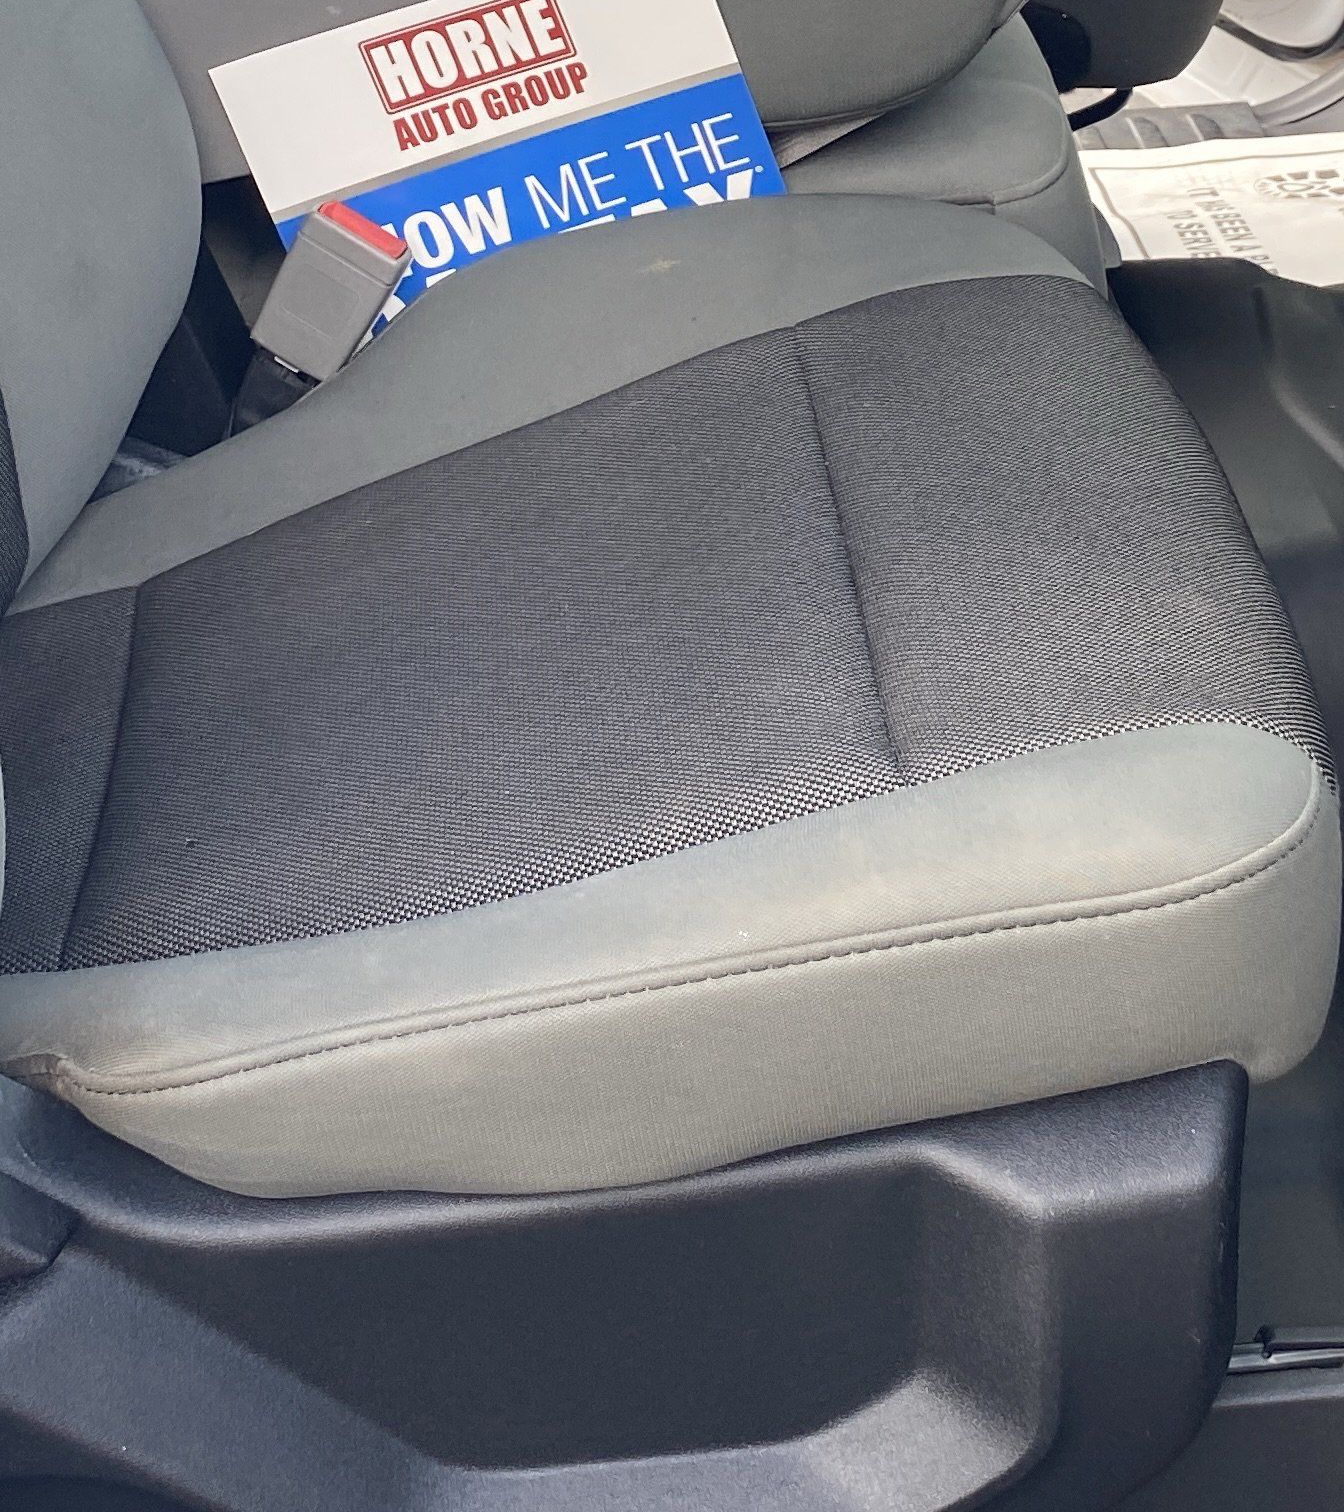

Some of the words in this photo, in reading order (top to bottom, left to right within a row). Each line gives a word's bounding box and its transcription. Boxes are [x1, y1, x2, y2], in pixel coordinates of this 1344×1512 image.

[393, 98, 478, 151] AUTO
[481, 62, 588, 120] GROUP
[381, 186, 513, 277] OW
[524, 151, 626, 229] ME
[625, 112, 751, 190] THE
[1187, 187, 1219, 196] IT
[1210, 213, 1258, 241] BEEN
[1229, 245, 1263, 253] A
